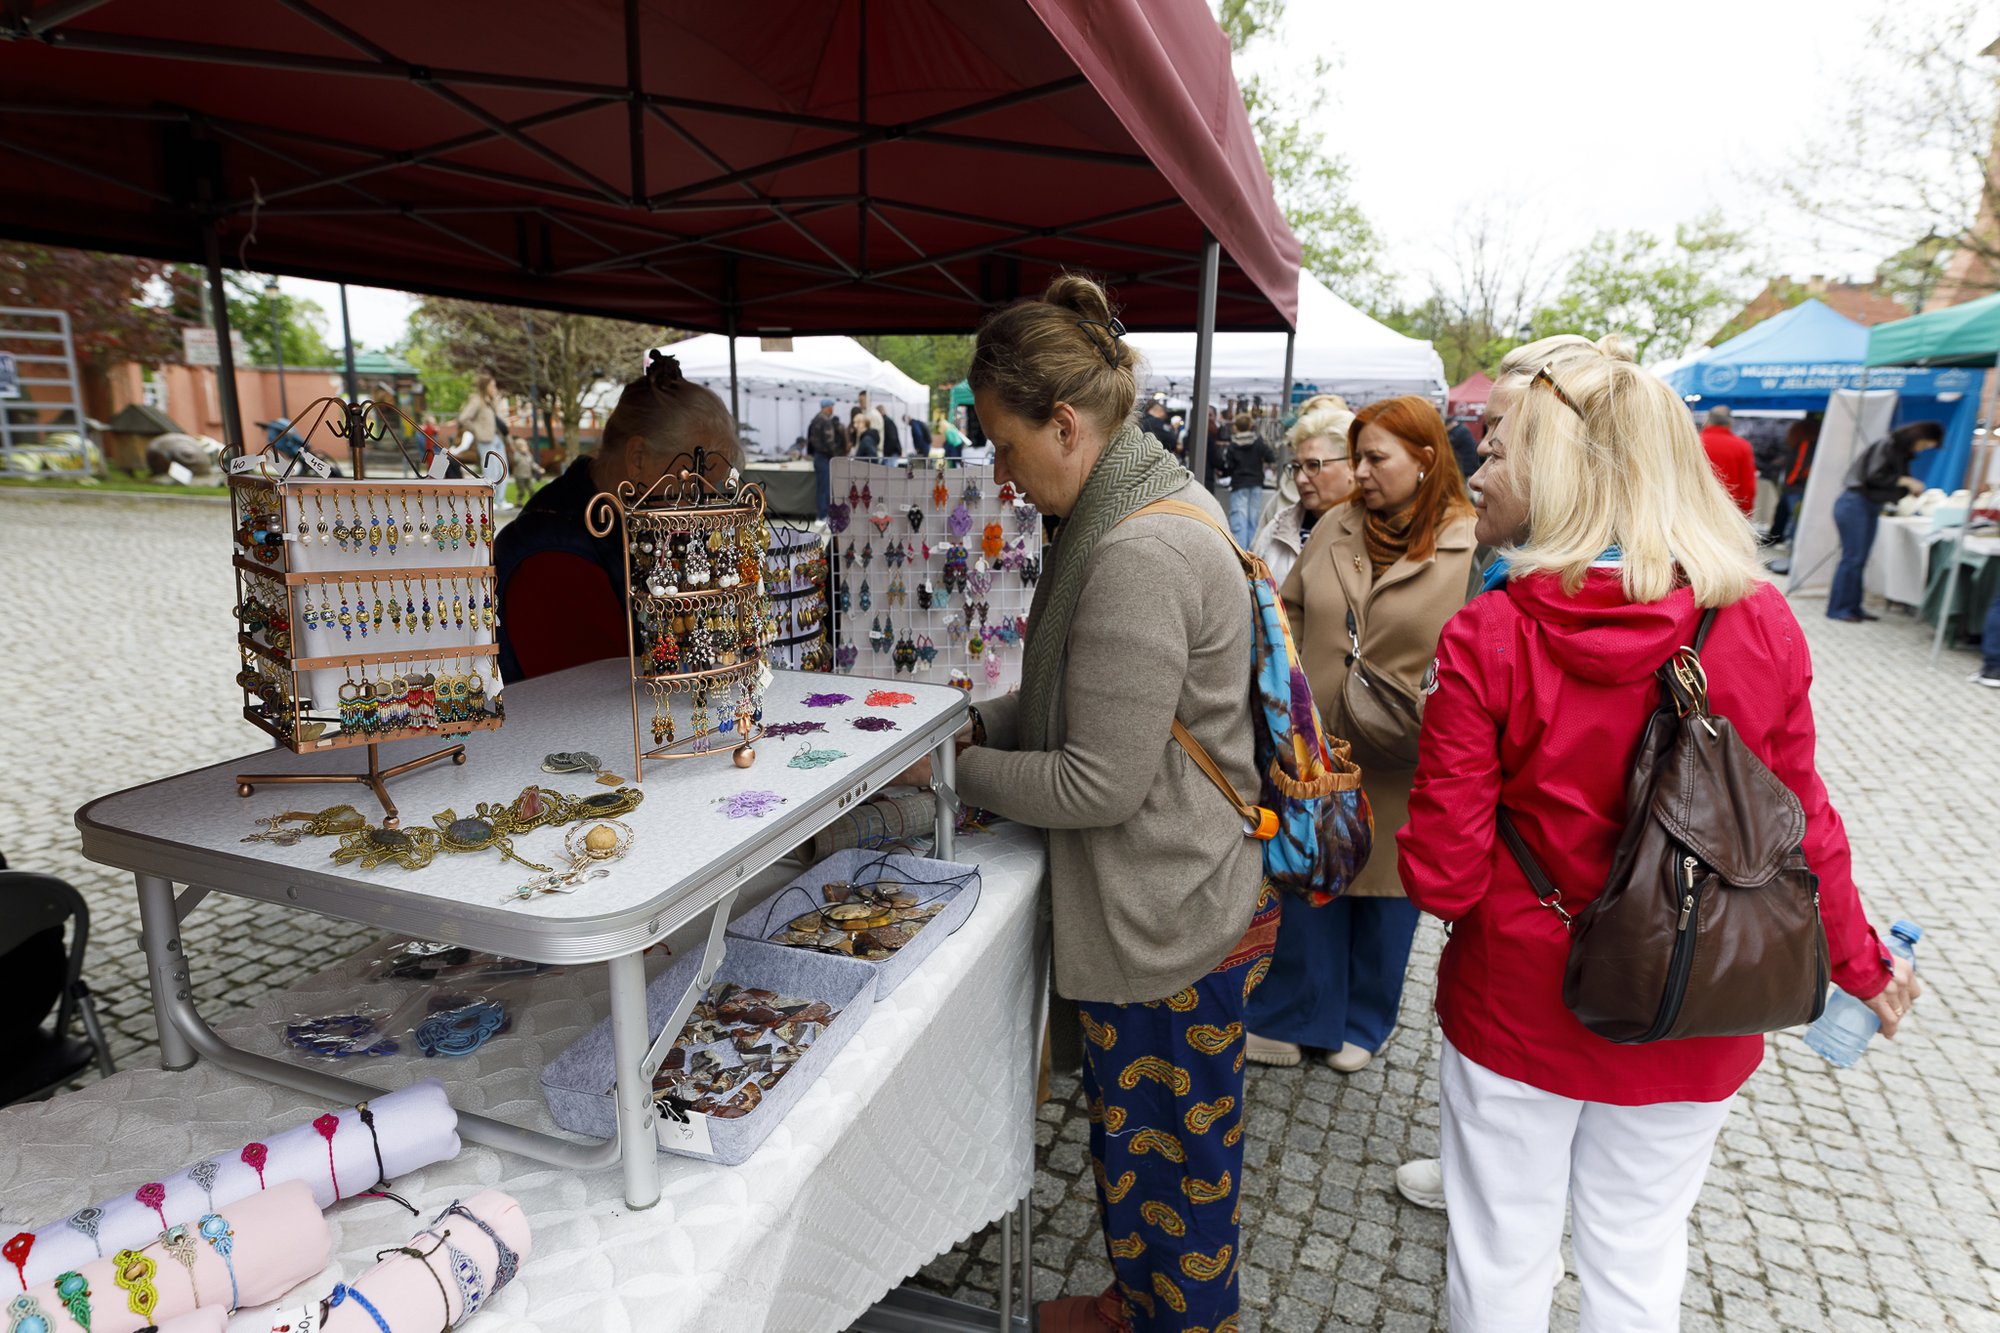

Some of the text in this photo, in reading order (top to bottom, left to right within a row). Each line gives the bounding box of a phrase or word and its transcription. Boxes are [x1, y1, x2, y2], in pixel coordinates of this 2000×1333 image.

[1740, 364, 1932, 378] MUZEUM PRZYRDNICZE
[1760, 377, 1778, 389] W
[1780, 377, 1849, 389] JELENIEJ
[232, 460, 246, 470] 40
[310, 458, 325, 471] 45
